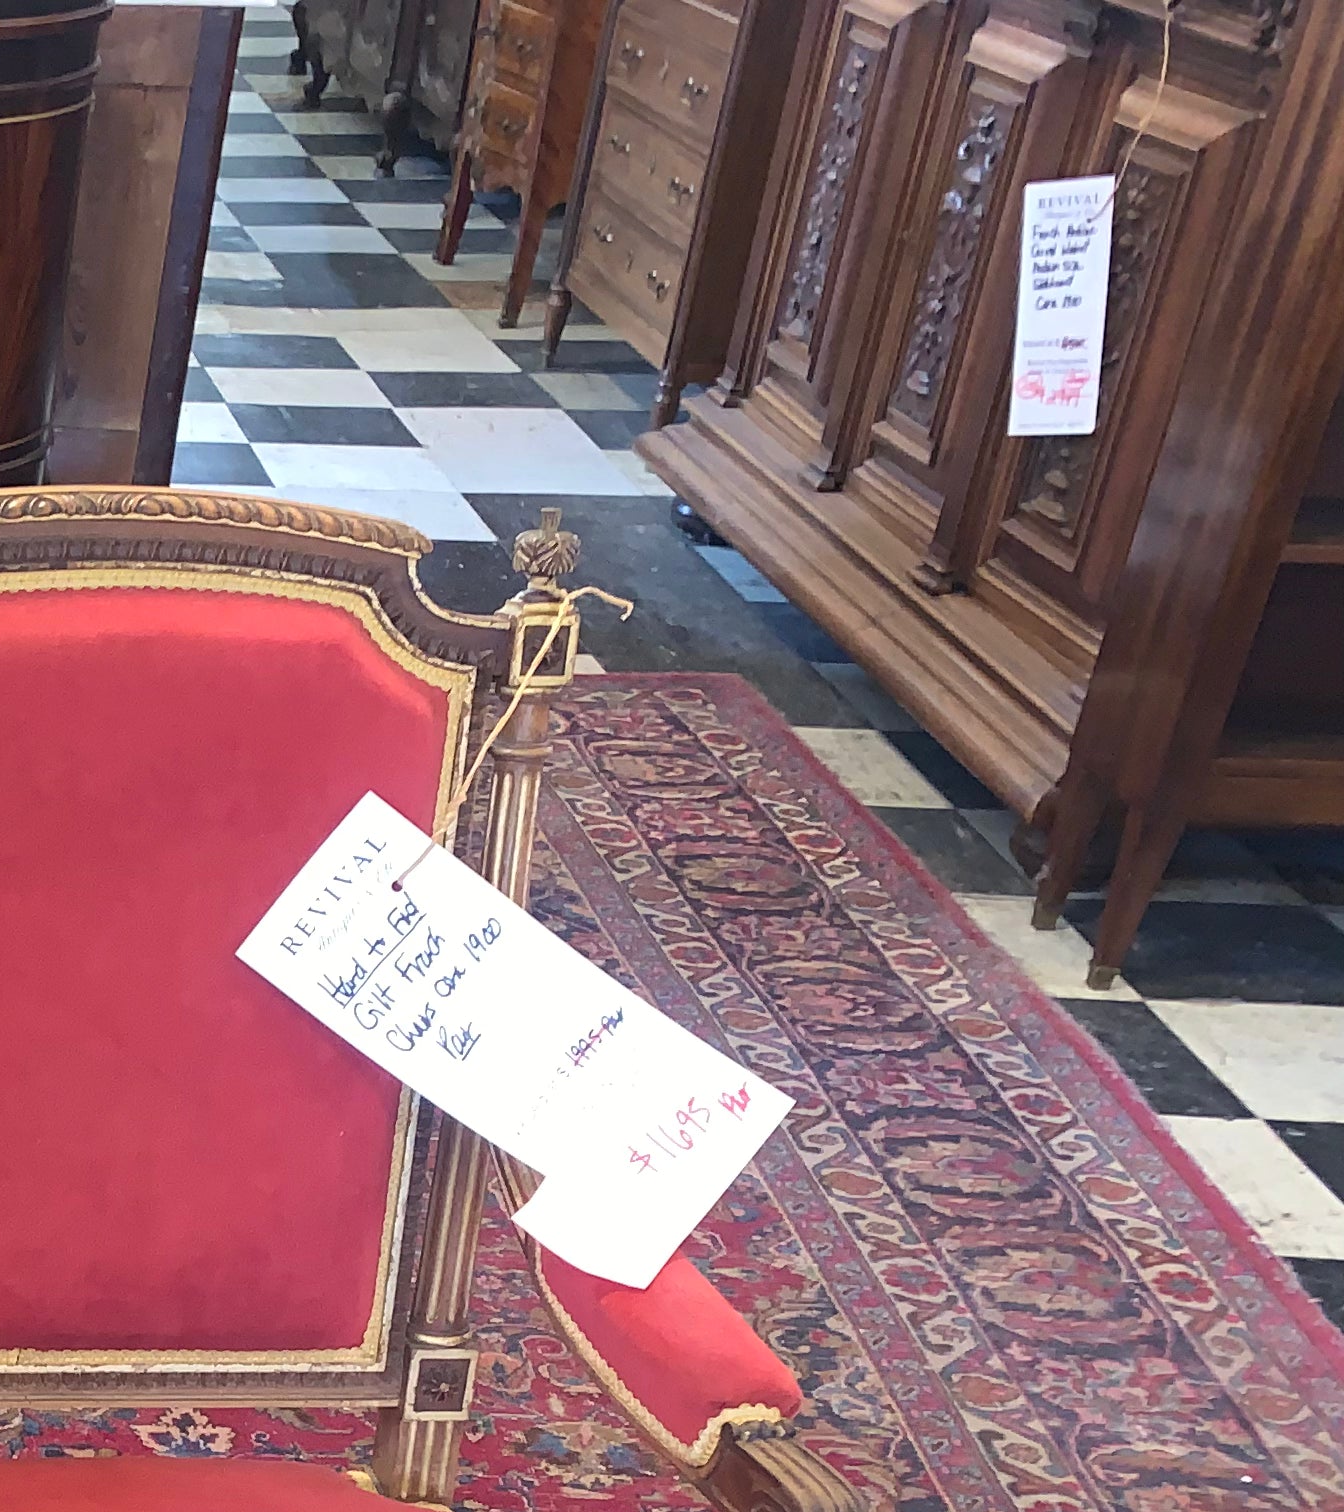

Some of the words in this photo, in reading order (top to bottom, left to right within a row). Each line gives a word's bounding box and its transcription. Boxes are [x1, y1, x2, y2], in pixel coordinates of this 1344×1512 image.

[1038, 192, 1099, 209] REVIVAL
[279, 838, 387, 956] REVIVAL
[317, 956, 374, 1007] Hard
[353, 982, 396, 1031] Gilt
